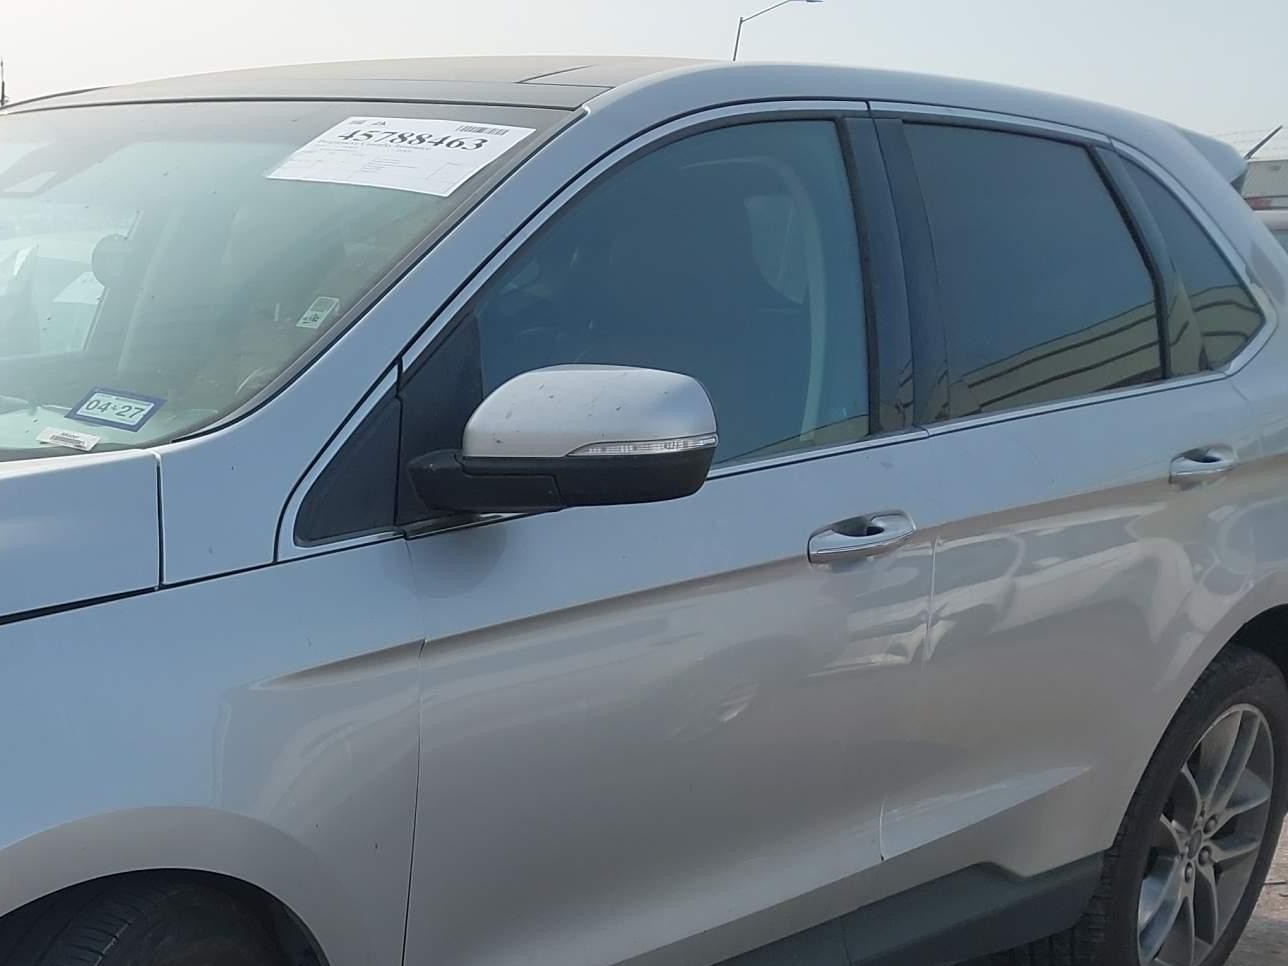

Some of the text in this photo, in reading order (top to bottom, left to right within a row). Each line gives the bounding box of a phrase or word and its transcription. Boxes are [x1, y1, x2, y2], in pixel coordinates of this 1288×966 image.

[337, 129, 489, 151] 45788463
[86, 399, 145, 418] 04 27
